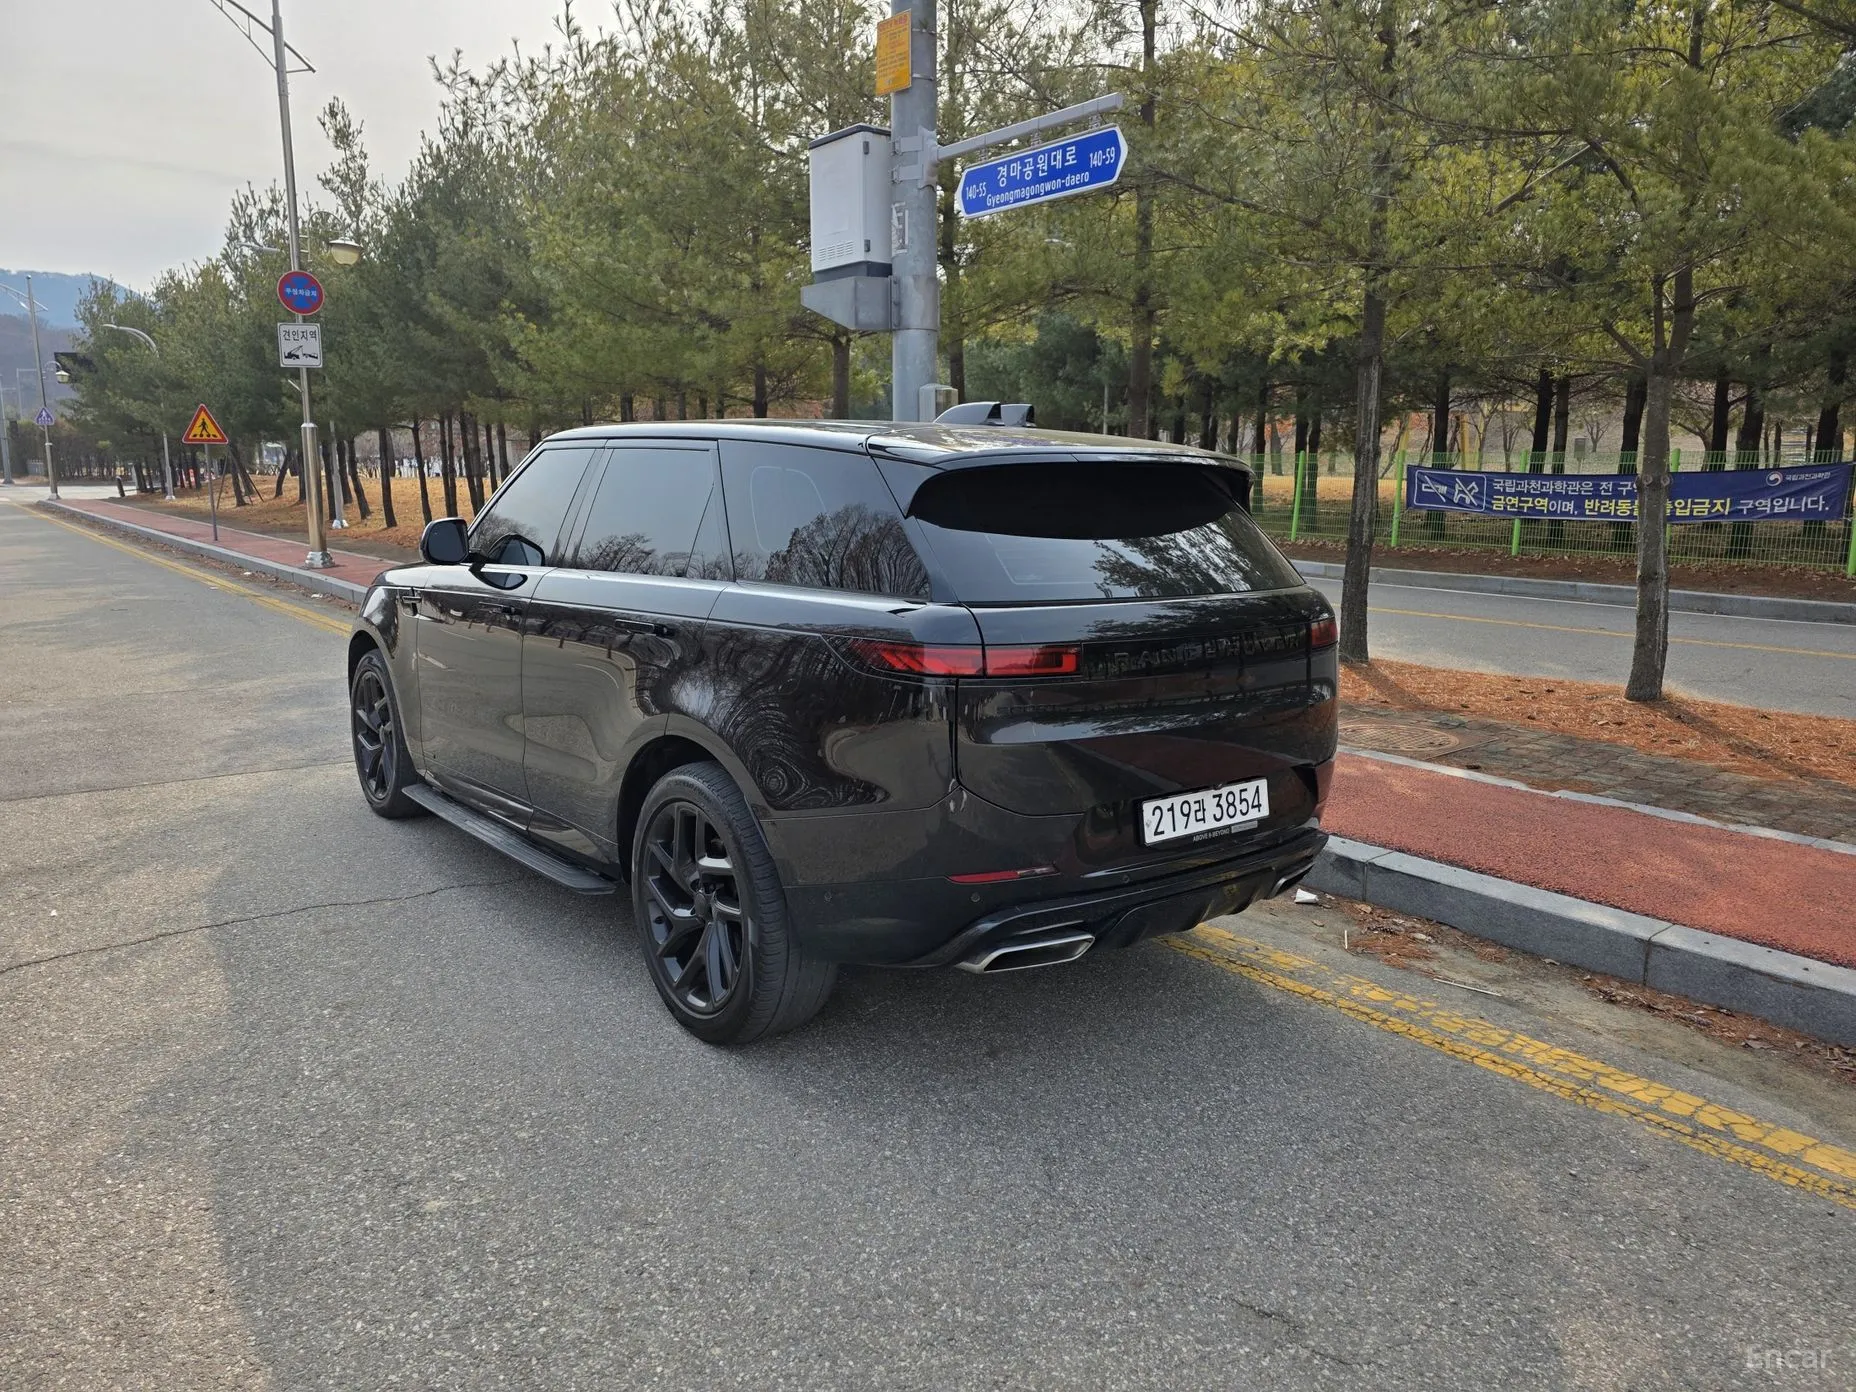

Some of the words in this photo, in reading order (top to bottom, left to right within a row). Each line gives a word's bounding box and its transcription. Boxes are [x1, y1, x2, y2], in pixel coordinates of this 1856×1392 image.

[997, 146, 1077, 187] 경마공원대로
[1090, 147, 1116, 167] 140-59
[966, 181, 987, 201] 140-55
[986, 171, 1090, 207] Gyeongmagongwon-daero
[282, 329, 317, 341] 견인지역
[1492, 479, 1594, 495] 국립과천과학관은
[1600, 481, 1613, 495] 전
[1491, 495, 1578, 515] 금연구역이며,
[1737, 495, 1829, 514] 구역입니다.
[1151, 798, 1206, 837] 219라
[1212, 785, 1262, 823] 3854
